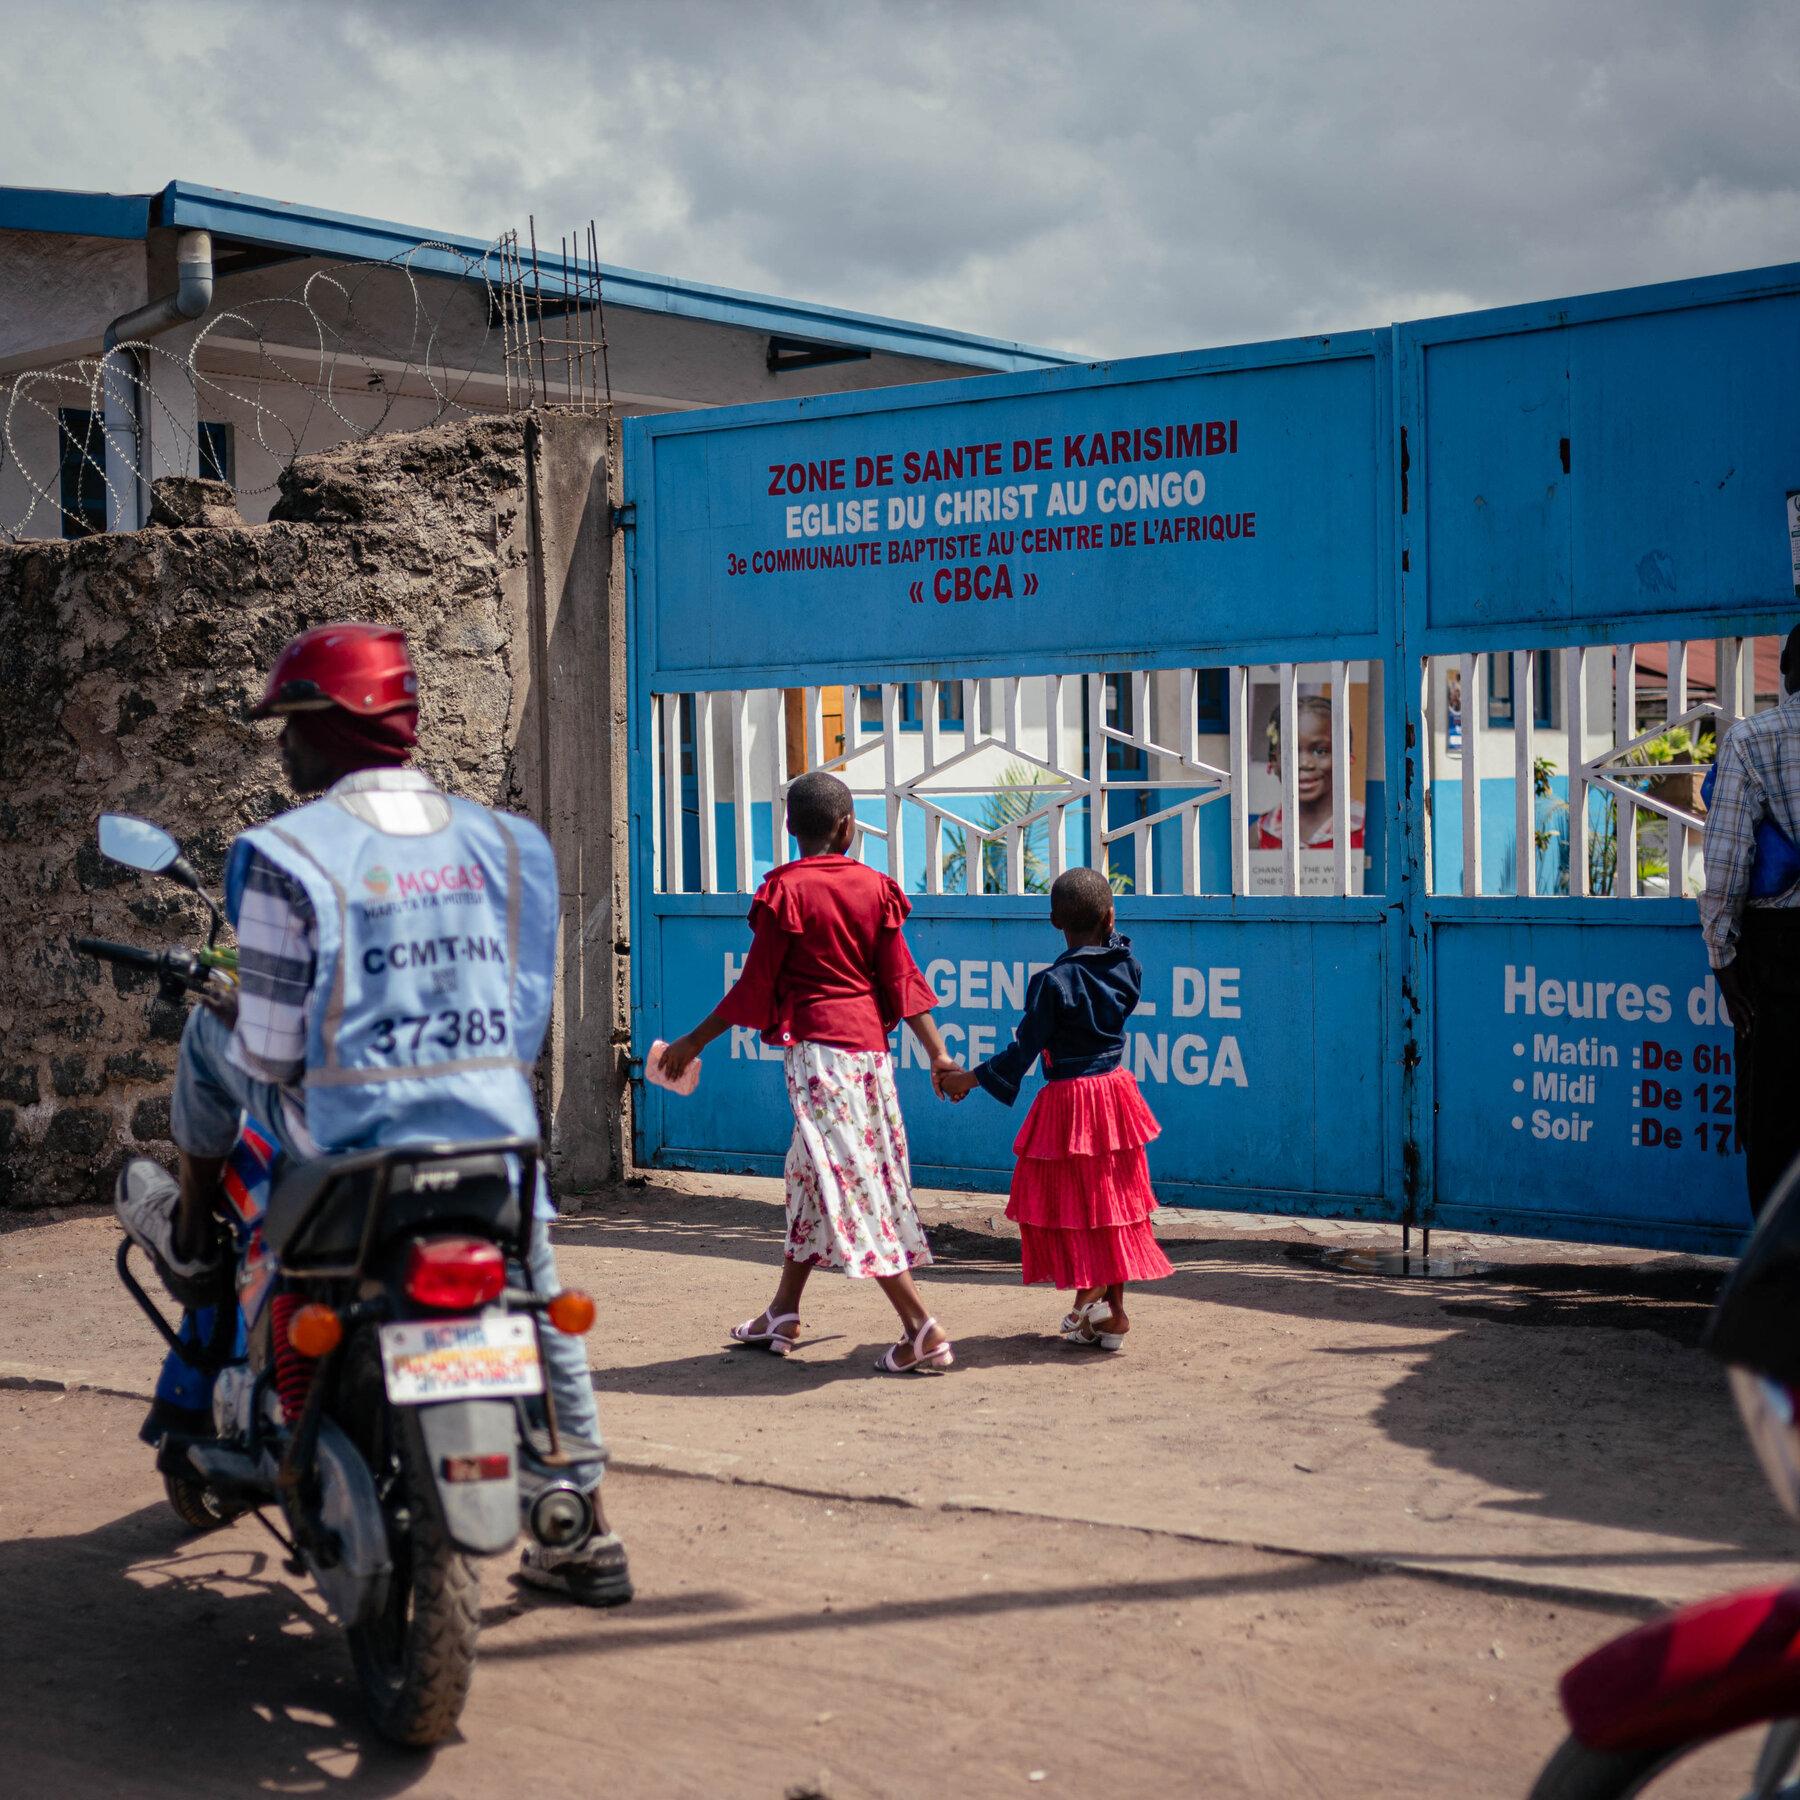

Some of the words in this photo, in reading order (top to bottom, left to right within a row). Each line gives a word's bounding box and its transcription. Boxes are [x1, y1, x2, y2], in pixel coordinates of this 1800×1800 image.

[767, 458, 846, 497] ZONE
[855, 454, 895, 489] DE
[902, 442, 1002, 484] SANTE
[1012, 438, 1053, 473] DE
[1064, 419, 1239, 468] KARISIMBI
[786, 499, 880, 539] EGLISE
[888, 495, 926, 530] DU
[934, 484, 1039, 526] CHRIST
[1046, 480, 1088, 516] AU
[1097, 469, 1207, 513] CONGO
[727, 552, 748, 577] 3e
[752, 541, 882, 575] COMMUNAUTE
[887, 533, 983, 565] BAPTISTE
[987, 531, 1015, 557] AU
[1021, 524, 1104, 555] CENTRE
[1110, 521, 1138, 549] DE
[1143, 511, 1257, 546] L'AFRIQUE
[933, 563, 1014, 604] CBCA
[397, 864, 485, 897] MOGAS
[1172, 966, 1242, 1019] DE
[1503, 964, 1673, 1023] Heures
[369, 1008, 506, 1054] 37385
[1532, 1033, 1619, 1068] Matin
[1532, 1071, 1596, 1105] Midi
[1530, 1108, 1594, 1143] Soir
